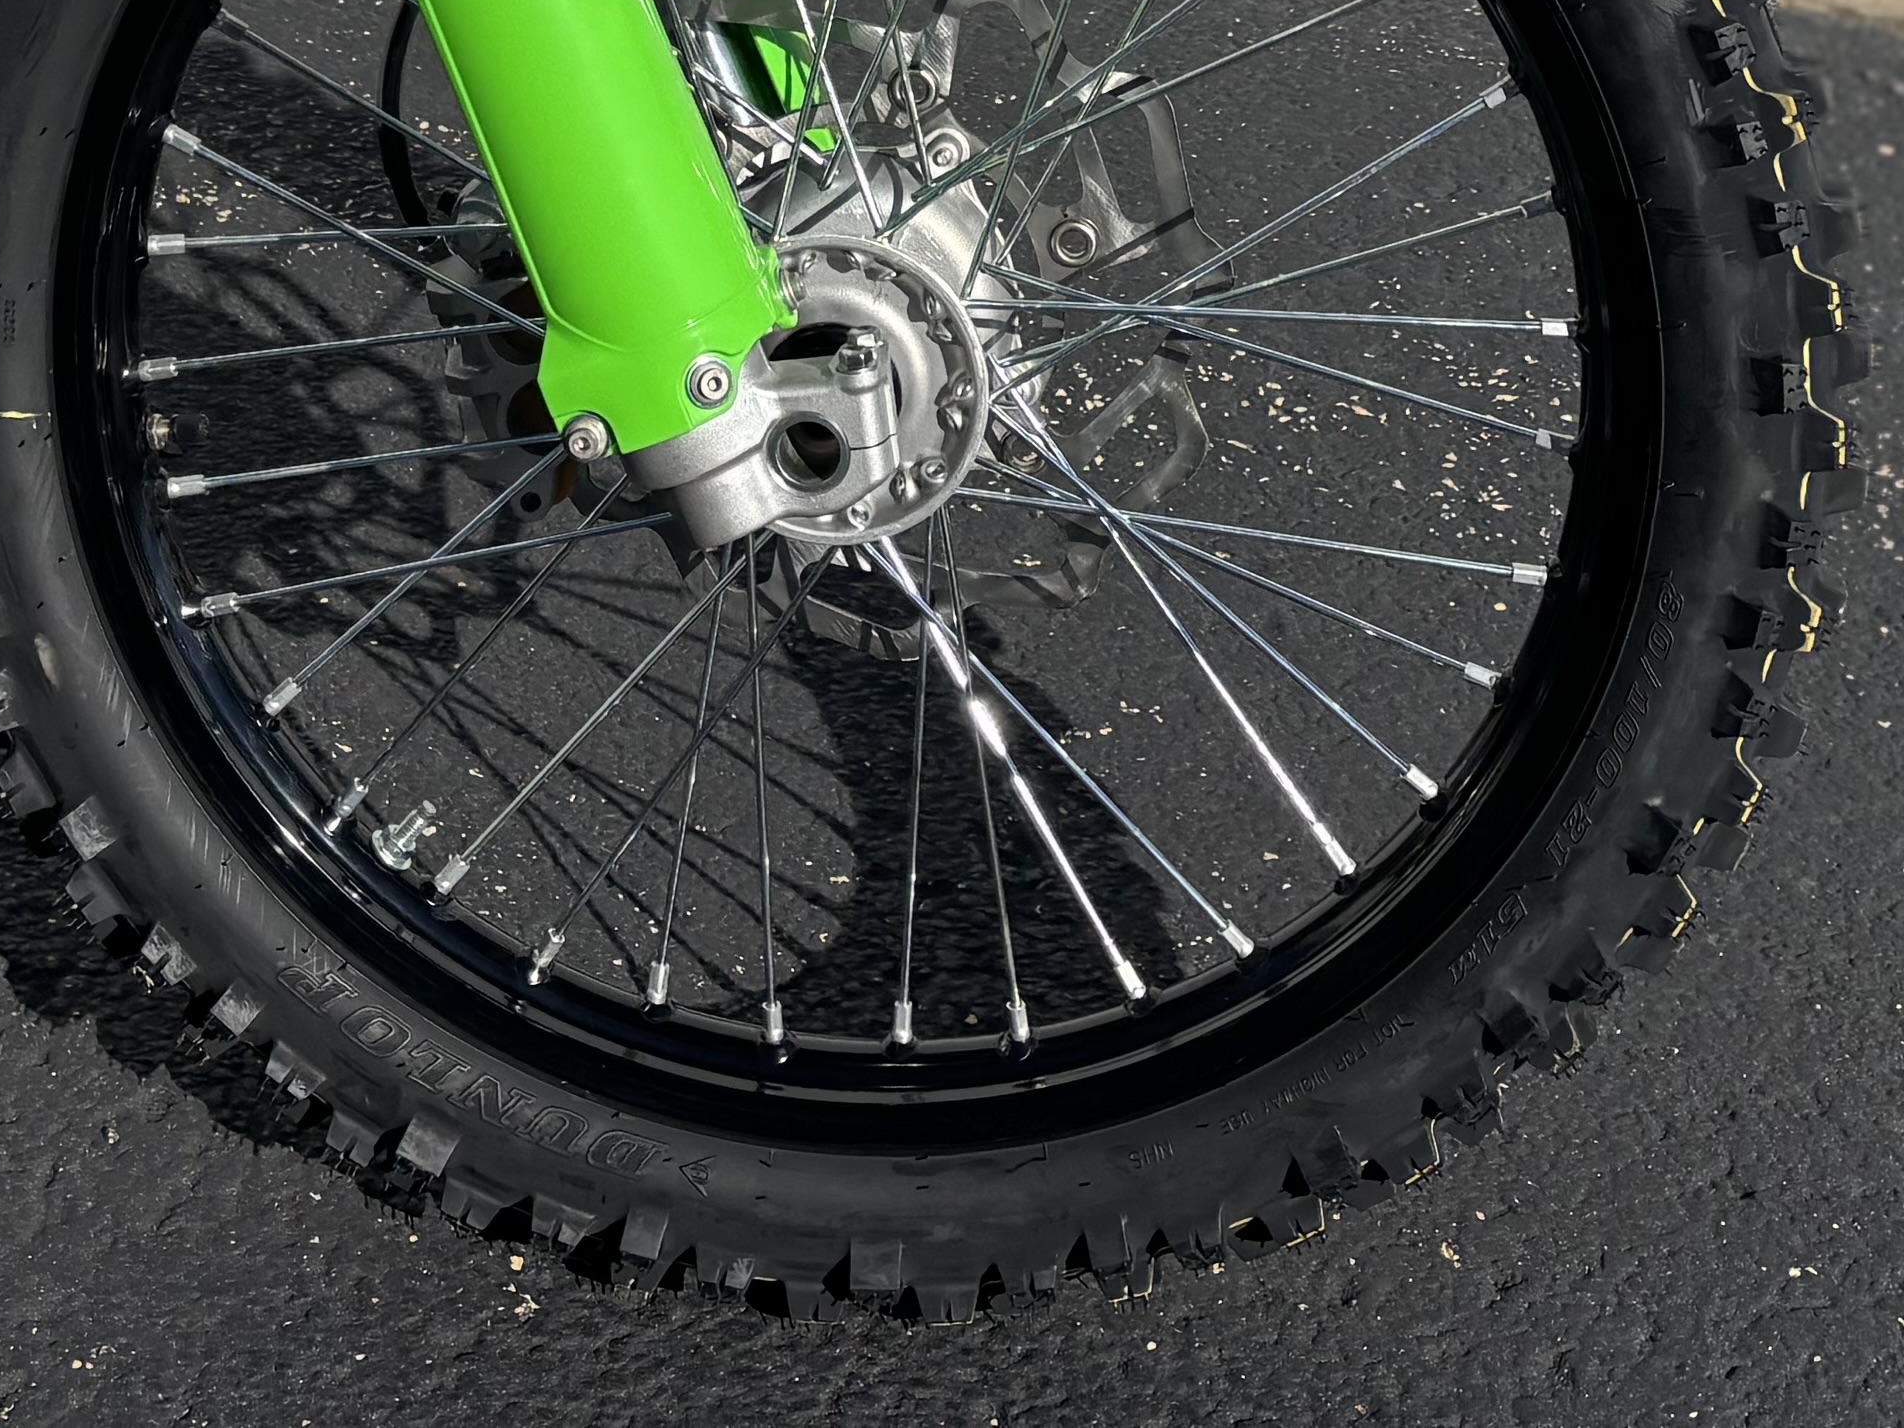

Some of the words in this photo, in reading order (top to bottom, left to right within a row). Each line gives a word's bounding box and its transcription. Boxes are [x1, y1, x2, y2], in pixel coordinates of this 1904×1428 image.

[1543, 583, 1687, 869] 80/100-21
[274, 964, 670, 1182] DUNLOP
[1334, 1041, 1368, 1073] FOR
[1126, 1137, 1177, 1170] NHS
